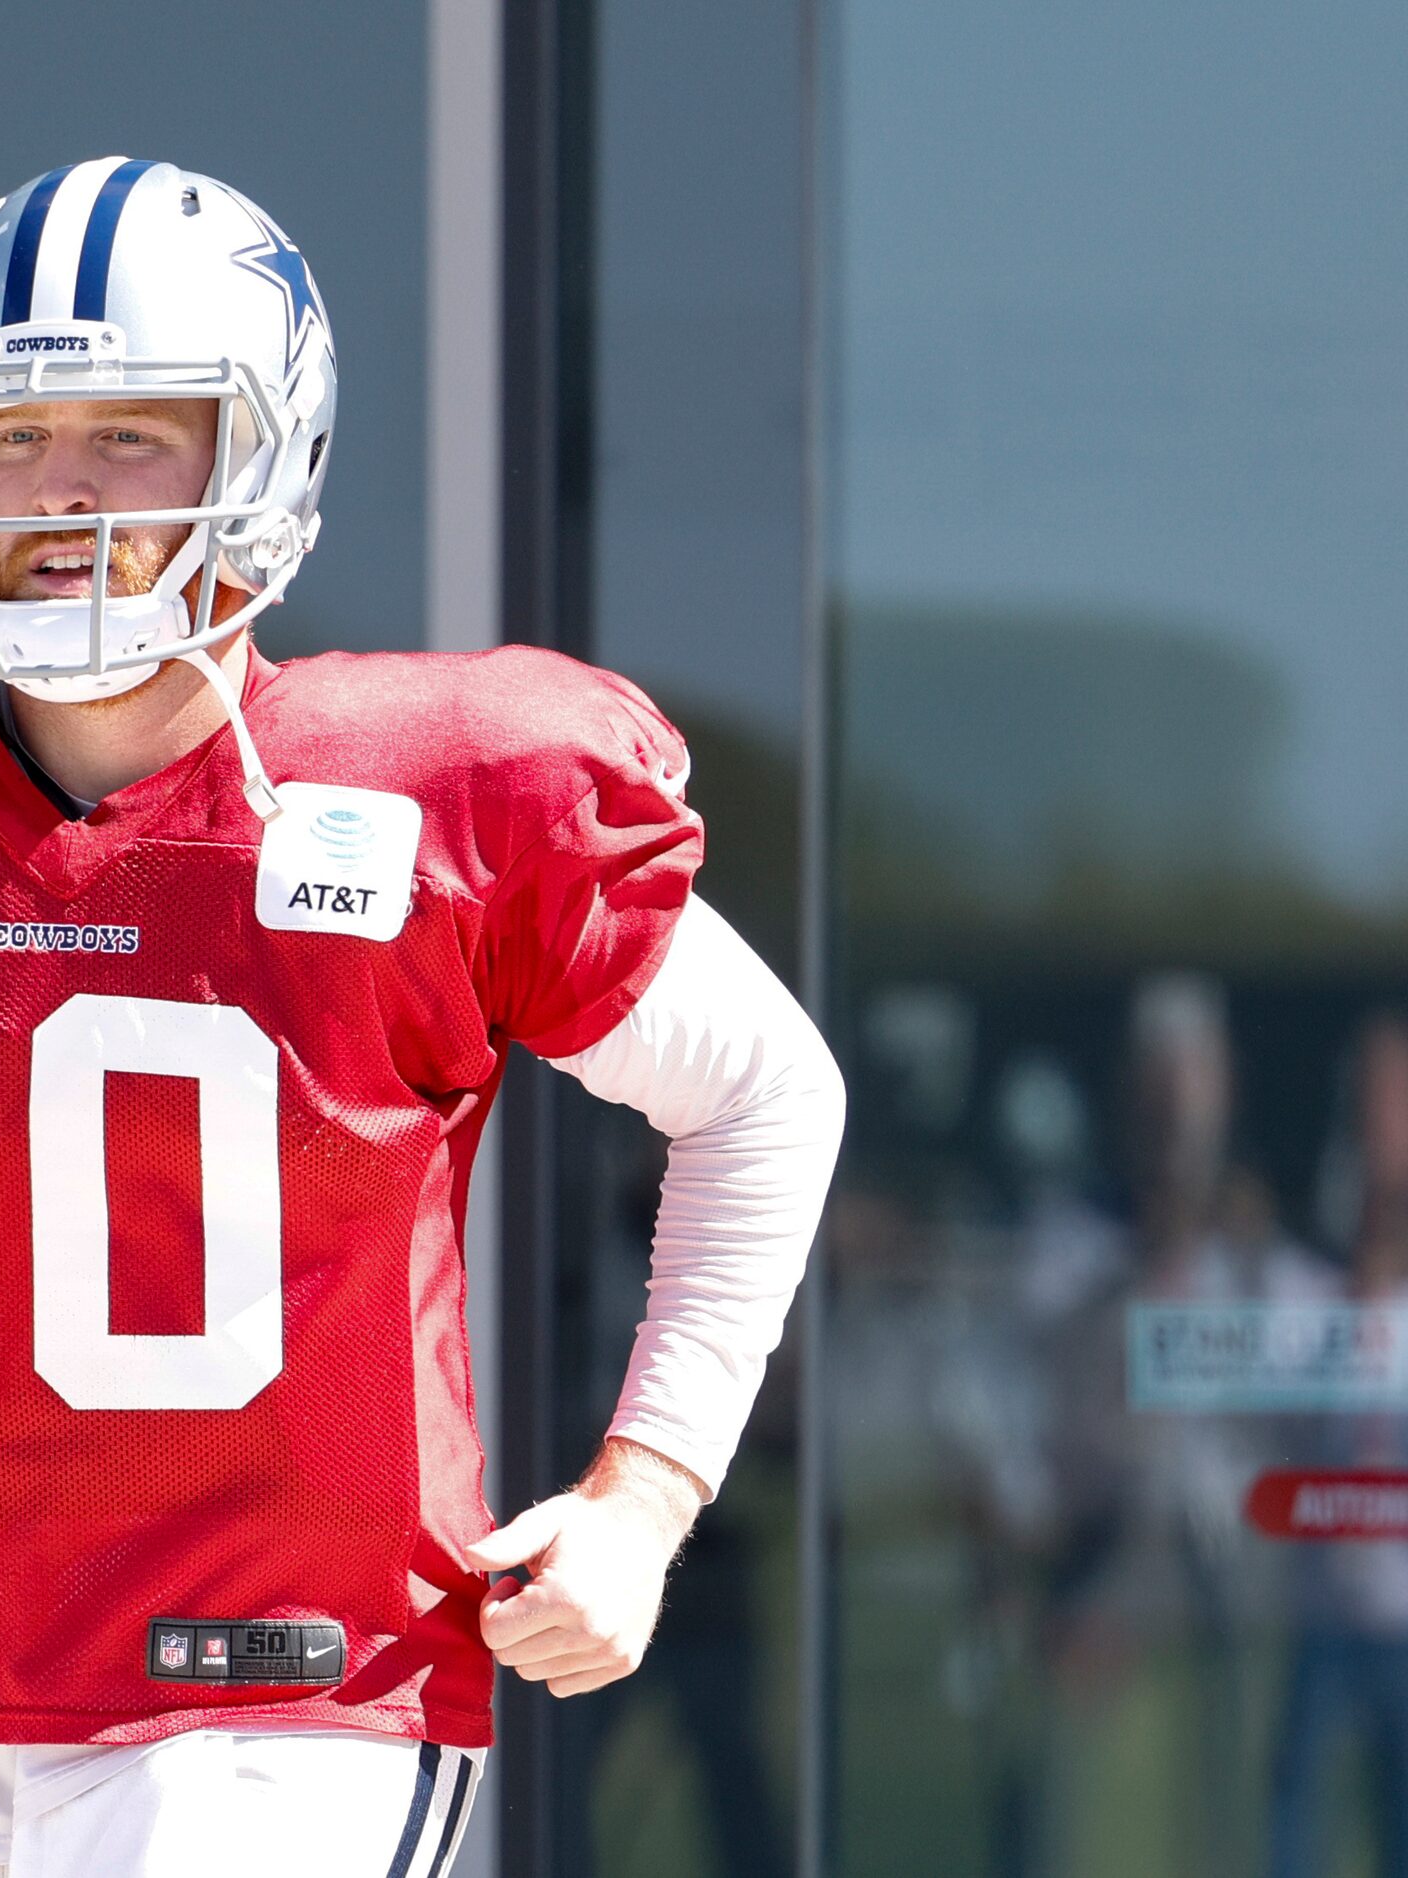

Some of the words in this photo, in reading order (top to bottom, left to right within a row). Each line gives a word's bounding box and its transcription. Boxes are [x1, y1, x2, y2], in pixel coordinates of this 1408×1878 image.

[6, 336, 89, 353] COWBOYS
[288, 881, 377, 916] AT&T
[246, 1631, 286, 1654] 50
[162, 1647, 184, 1663] NFL
